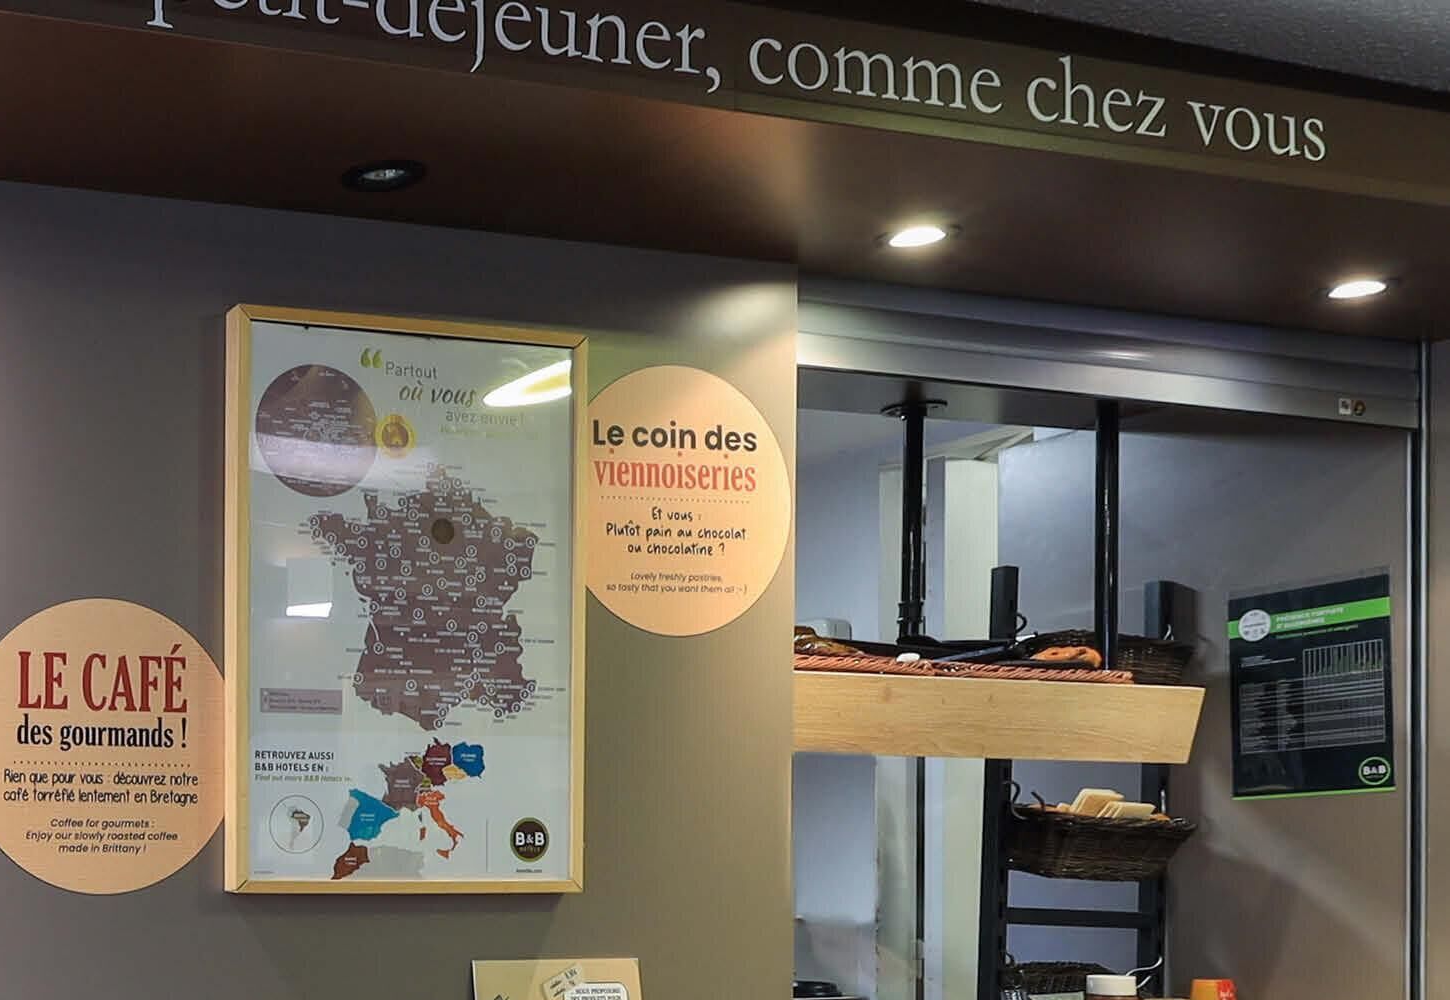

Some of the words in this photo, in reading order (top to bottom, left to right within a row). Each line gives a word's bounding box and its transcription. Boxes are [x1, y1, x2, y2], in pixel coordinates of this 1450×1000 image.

[749, 37, 1002, 114] comme
[1026, 56, 1166, 137] chez
[1187, 100, 1326, 161] vous
[385, 362, 437, 380] Partout
[399, 380, 423, 401] où
[430, 387, 476, 407] vous
[445, 411, 477, 425] avez
[593, 419, 624, 446] Le
[632, 421, 696, 449] coin
[704, 425, 757, 451] des
[594, 448, 757, 492] viennoiseries
[651, 506, 662, 520] Et
[667, 511, 693, 521] vous
[606, 520, 641, 536] Plutôt
[646, 525, 671, 541] pain
[677, 529, 692, 538] au
[697, 528, 746, 540] chocolat
[627, 544, 641, 553] ou
[647, 543, 713, 556] chocolatine
[719, 542, 725, 555] ?
[641, 584, 659, 592] that
[661, 585, 676, 594] you
[700, 584, 722, 593] them
[18, 651, 68, 710] LE
[82, 644, 187, 713] CAFÉ
[17, 714, 51, 745] des
[60, 717, 173, 751] gourmands
[181, 717, 186, 748] !
[254, 750, 306, 760] RETROUVEZ
[309, 751, 334, 760] AUSSI
[254, 763, 274, 772] B&B
[276, 763, 309, 772] HOTELS
[312, 763, 323, 772] EN
[4, 769, 26, 783] Rien
[29, 773, 48, 789] que
[52, 773, 75, 786] pour
[80, 773, 103, 784] vous
[113, 772, 166, 786] découvrez
[170, 773, 198, 786] notre
[4, 788, 28, 801] café
[32, 789, 75, 802] torréfié
[79, 789, 129, 803] lentement
[134, 793, 147, 803] en
[150, 790, 198, 806] Bretagne
[50, 818, 83, 828] Coffee
[85, 818, 99, 828] for
[102, 819, 149, 830] gourmets
[26, 831, 52, 841] Enjoy
[55, 832, 72, 840] our
[74, 831, 103, 842] slowly
[107, 831, 145, 841] roasted
[148, 832, 178, 841] coffee
[515, 832, 545, 846] B&B
[59, 844, 88, 853] made
[90, 844, 99, 853] in
[102, 844, 141, 855] Brittany
